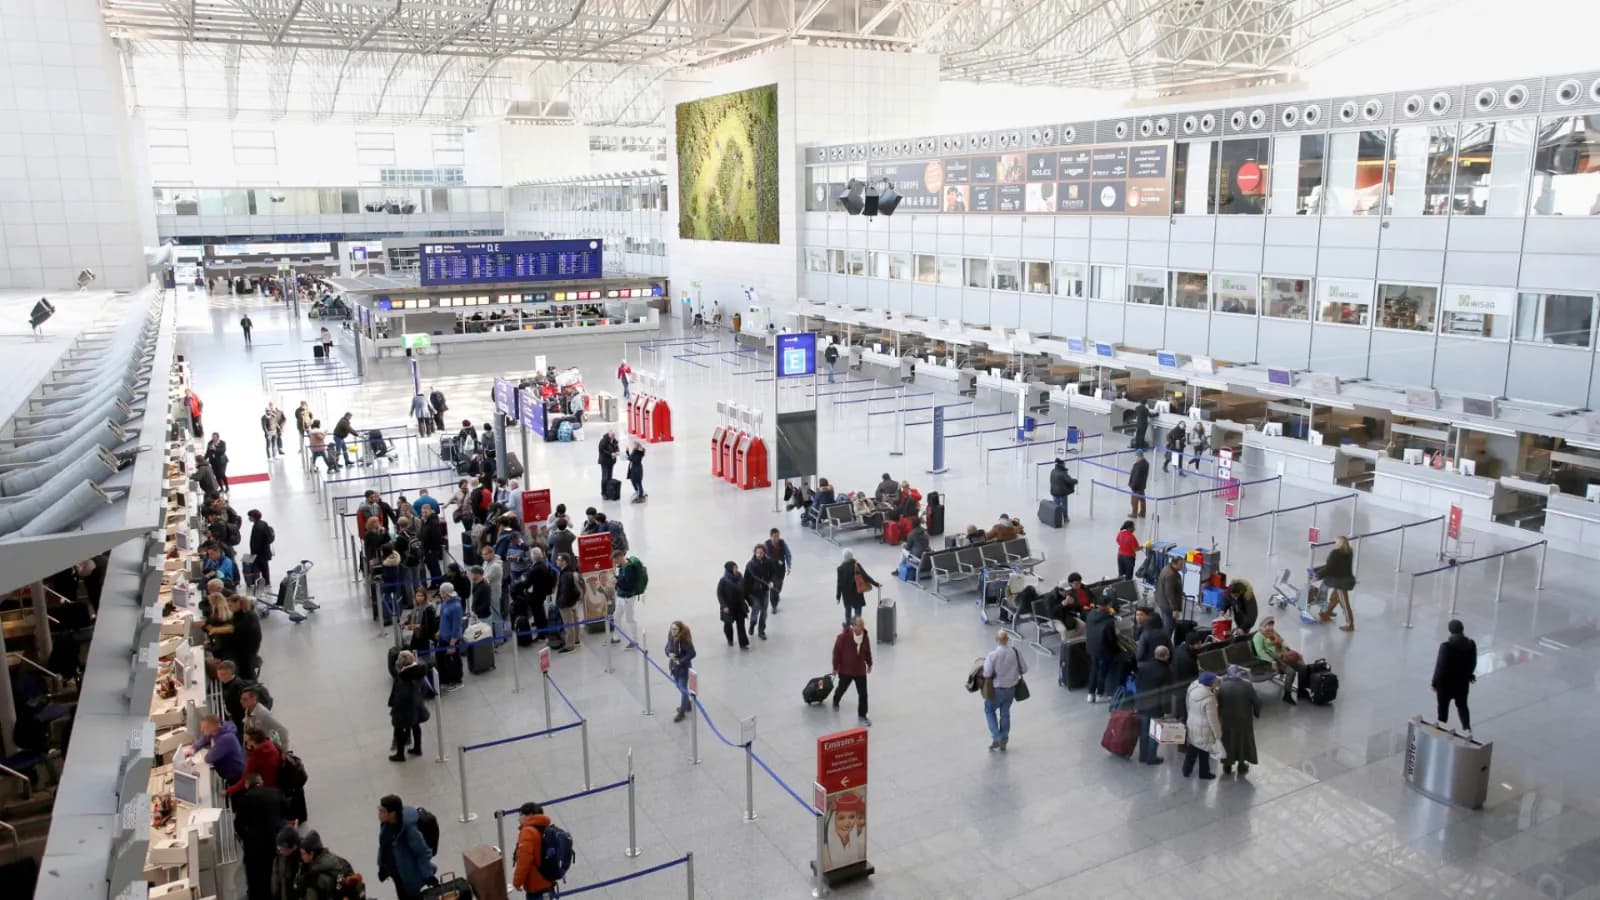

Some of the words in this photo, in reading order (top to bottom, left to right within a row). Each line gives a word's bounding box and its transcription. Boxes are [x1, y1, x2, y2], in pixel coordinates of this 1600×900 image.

[1031, 168, 1052, 176] ROLEX
[790, 354, 799, 368] E
[824, 738, 855, 750] Emirates
[1407, 743, 1417, 775] waste
